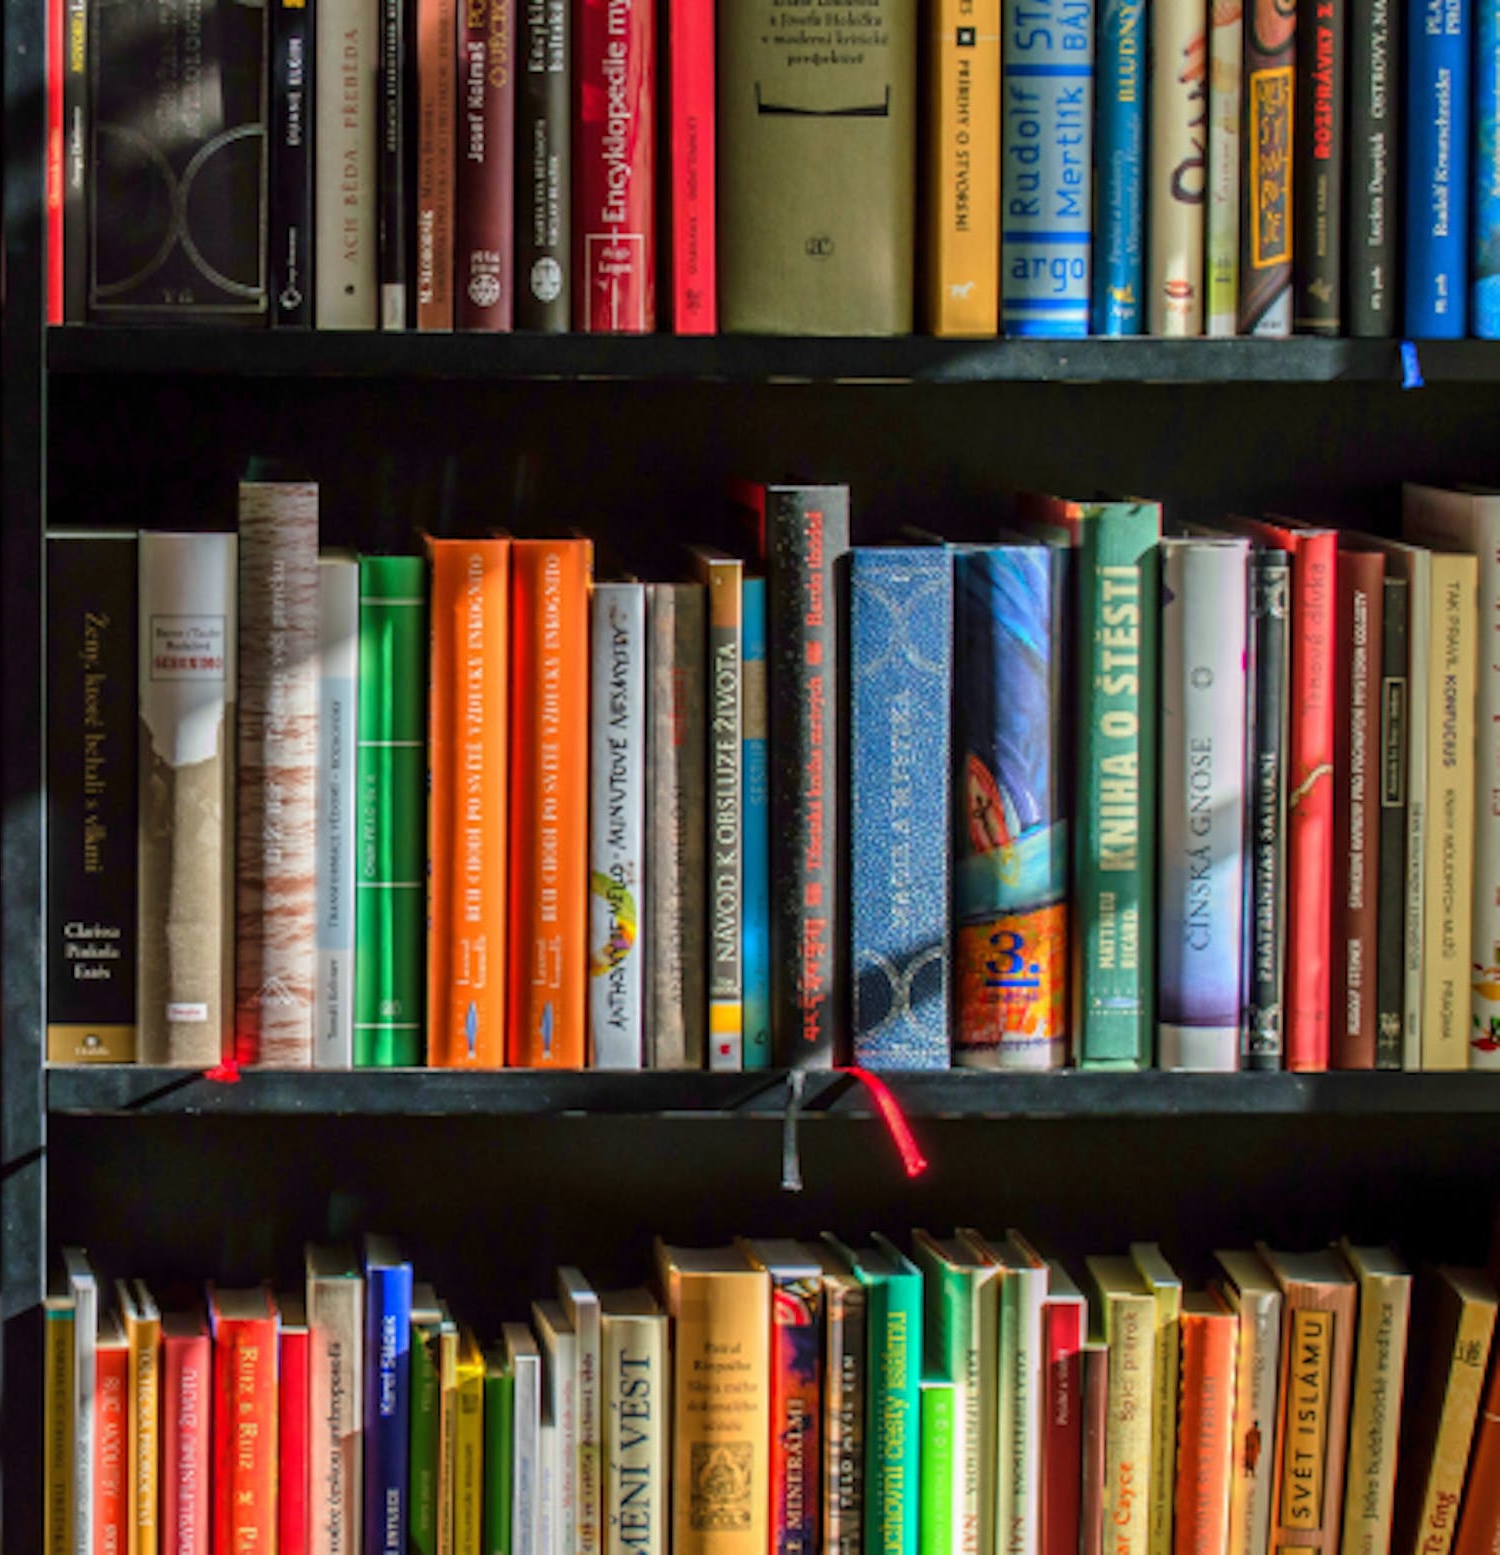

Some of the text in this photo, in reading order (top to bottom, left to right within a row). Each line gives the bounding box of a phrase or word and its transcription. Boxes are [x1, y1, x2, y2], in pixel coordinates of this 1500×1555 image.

[1014, 0, 1052, 51] ST
[466, 114, 486, 163] Josef
[600, 40, 633, 223] Encyklopedie
[1009, 84, 1040, 219] Rudolf
[1054, 84, 1084, 219] Mertlík
[1311, 26, 1335, 160] ROZPRÁVKY
[342, 218, 360, 264] ACH
[1011, 253, 1086, 293] argo
[1095, 565, 1140, 872] KNIHA O ŠTĚSTÍ
[711, 642, 737, 963] NÁVOD K OBSLUZE ŽIVOTA
[1183, 736, 1214, 952] ČÍNSKÁ GNOSE
[984, 930, 1041, 975] 3.
[610, 1348, 651, 1453] VÉST
[1289, 1320, 1323, 1519] SVĚT ISLÁMU
[1111, 1460, 1137, 1527] Cayce
